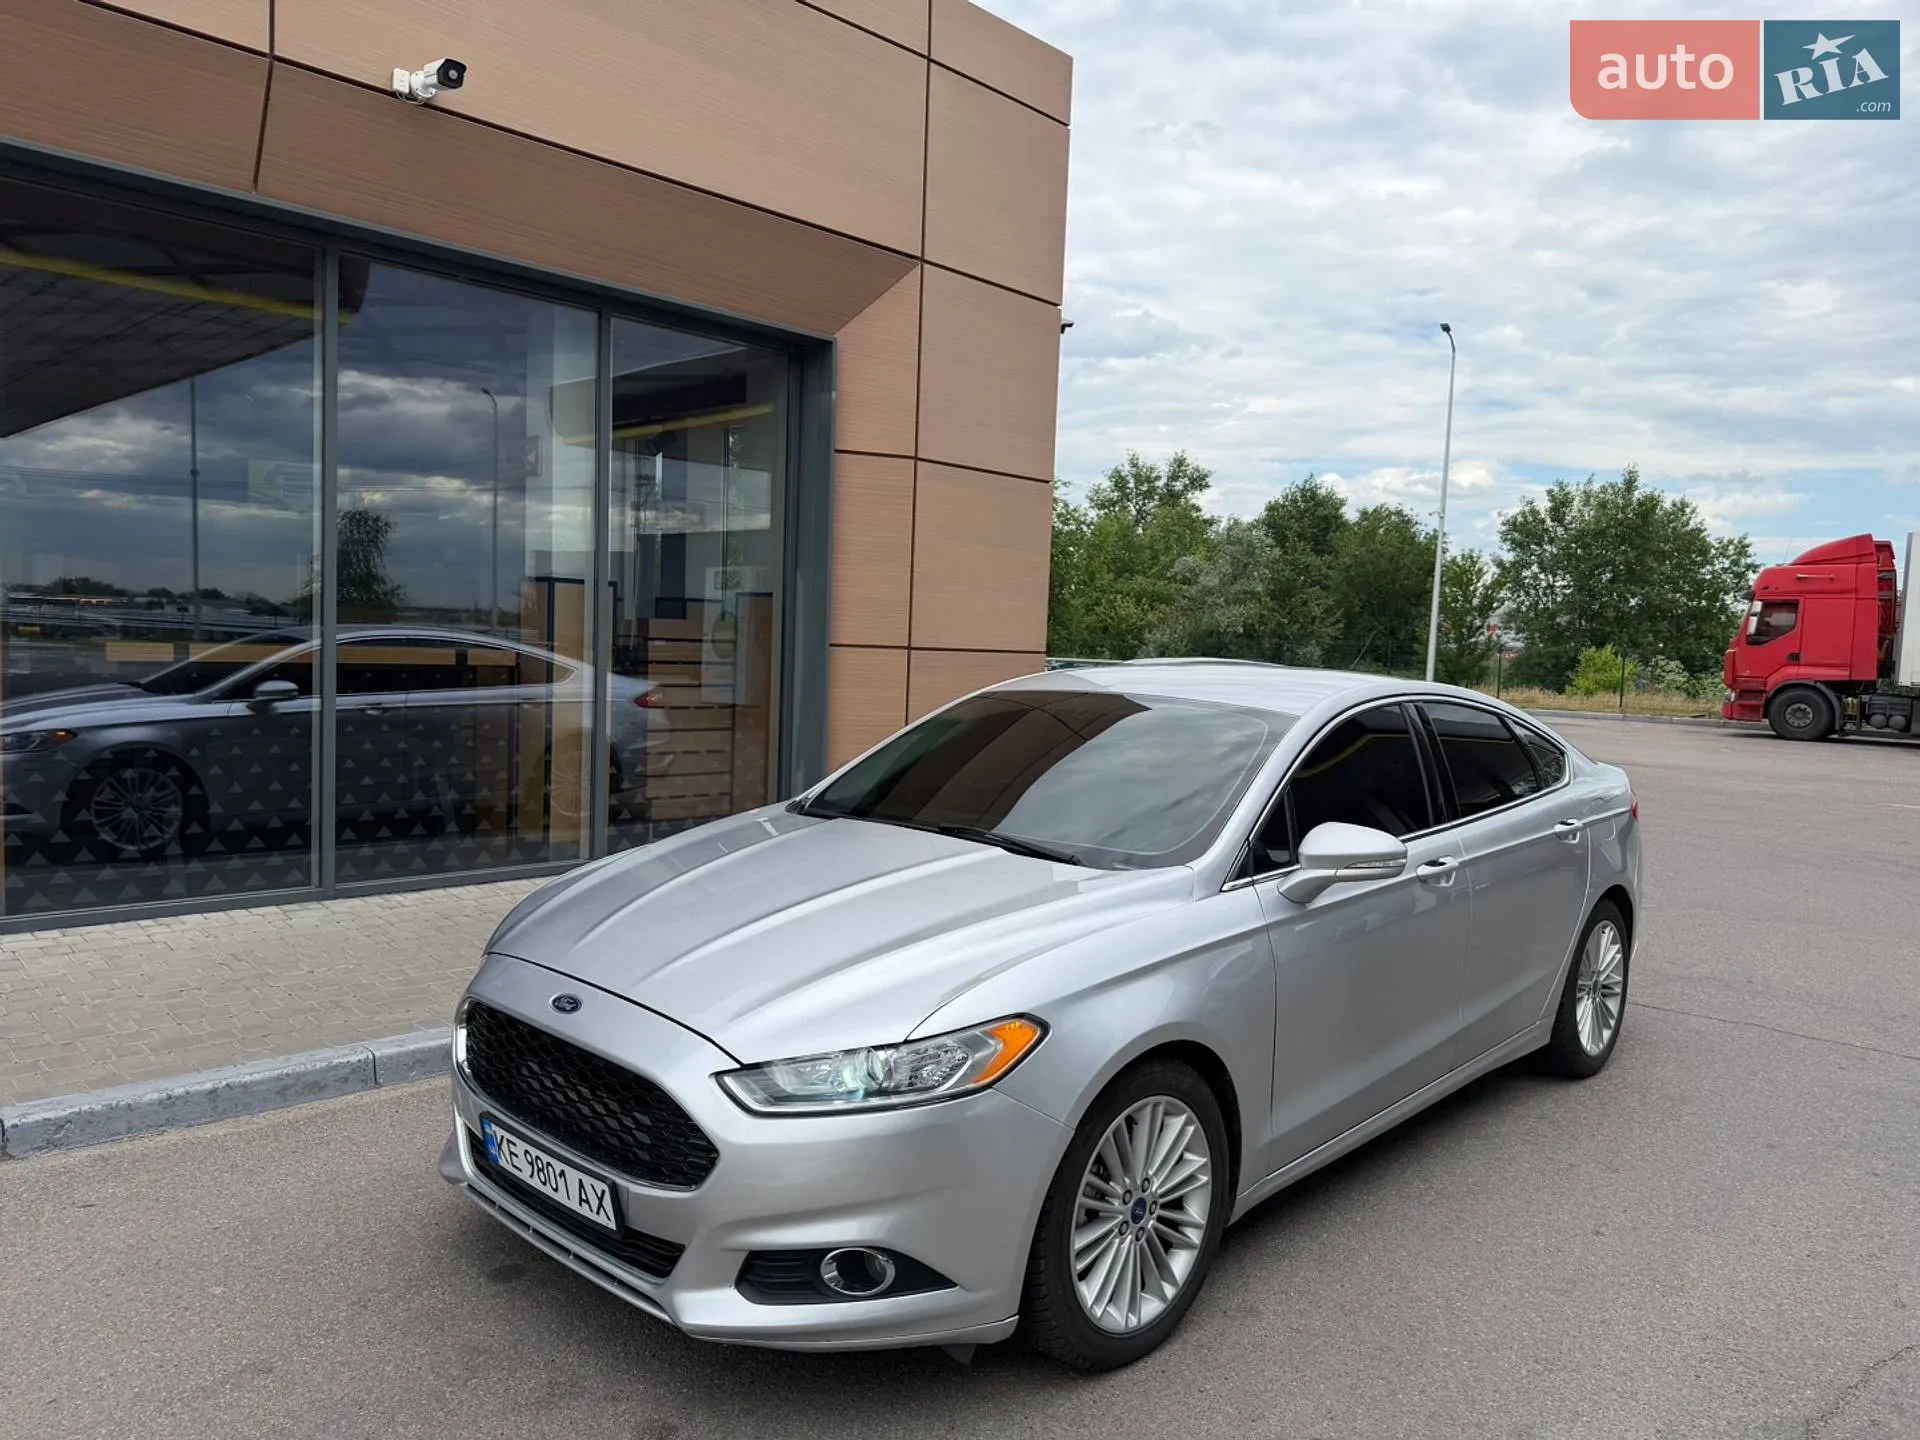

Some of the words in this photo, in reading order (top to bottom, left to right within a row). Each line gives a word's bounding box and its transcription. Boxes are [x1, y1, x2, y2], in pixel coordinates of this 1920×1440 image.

[494, 1130, 523, 1173] KE
[523, 1149, 571, 1201] 9801
[578, 1178, 612, 1222] AX
